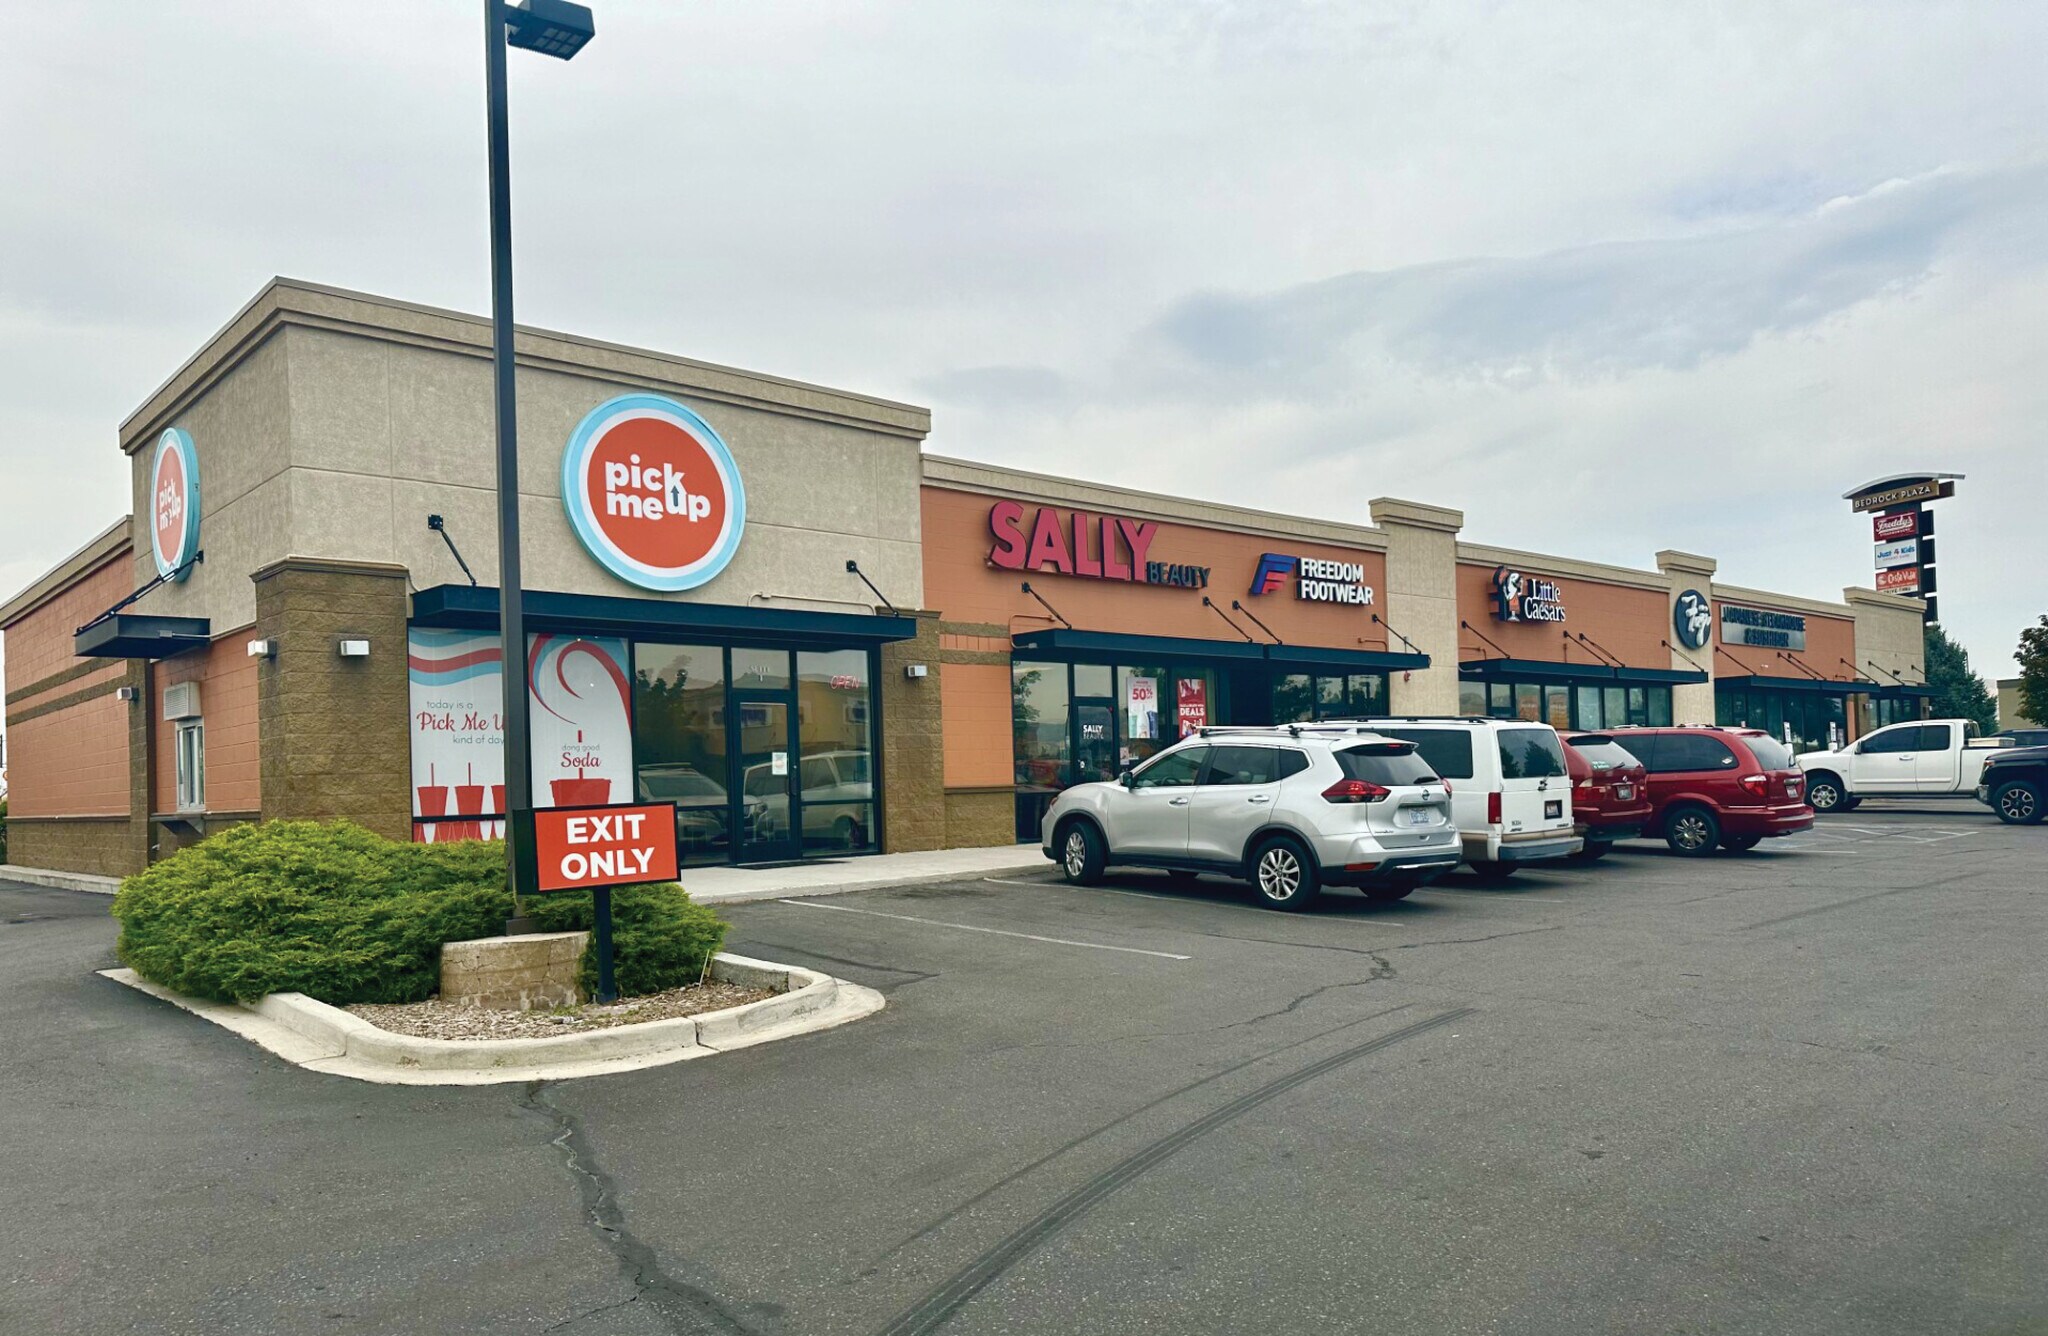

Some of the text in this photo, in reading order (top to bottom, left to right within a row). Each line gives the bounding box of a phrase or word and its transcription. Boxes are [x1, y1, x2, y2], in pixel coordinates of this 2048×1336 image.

[604, 453, 687, 492] pick
[159, 478, 176, 513] pick
[1854, 486, 1931, 508] BEDROCK PLAZA
[989, 500, 1211, 588] SALLY BEAUTY
[1300, 557, 1365, 583] FREEDOM
[1300, 580, 1375, 605] FOOTWEAR
[1532, 578, 1561, 603] Little
[1524, 597, 1566, 622] Caesars
[830, 675, 861, 690] OPEN
[426, 699, 454, 710] today
[456, 700, 464, 709] is
[1180, 707, 1205, 716] DEALS
[416, 711, 505, 732] Pick Me U
[1083, 724, 1104, 733] SALLY
[452, 734, 505, 745] kind of day
[561, 751, 602, 768] Soda
[566, 813, 646, 845] EXIT
[560, 846, 655, 881] ONLY
